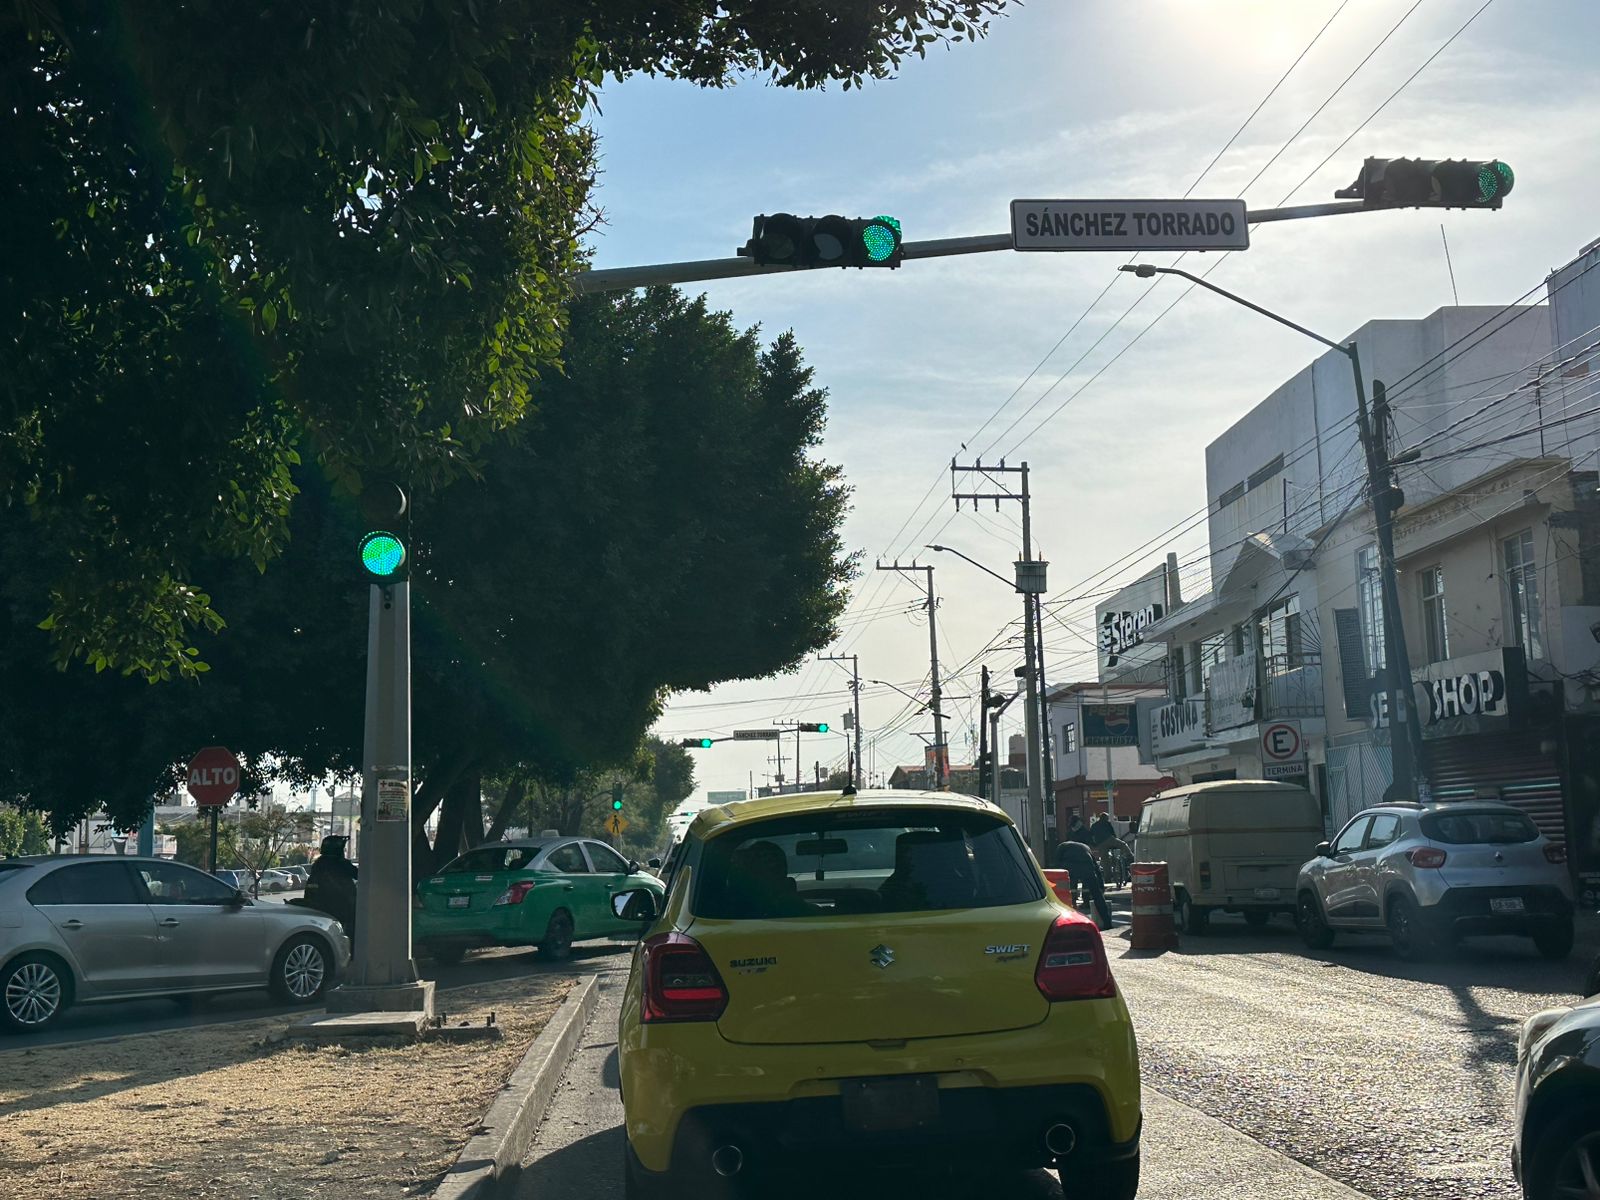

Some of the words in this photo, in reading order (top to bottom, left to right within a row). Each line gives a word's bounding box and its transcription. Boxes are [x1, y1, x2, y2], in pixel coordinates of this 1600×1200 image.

[1026, 208, 1128, 236] SÁNCHEZ
[1133, 212, 1235, 236] TORRADO
[1432, 671, 1494, 720] SHOP
[1088, 704, 1130, 716] PEPSI
[1272, 730, 1290, 753] E
[189, 767, 236, 786] ALTO
[1265, 764, 1303, 776] TERMINA
[984, 944, 1031, 954] SWIFT
[729, 956, 777, 968] SUZUKI
